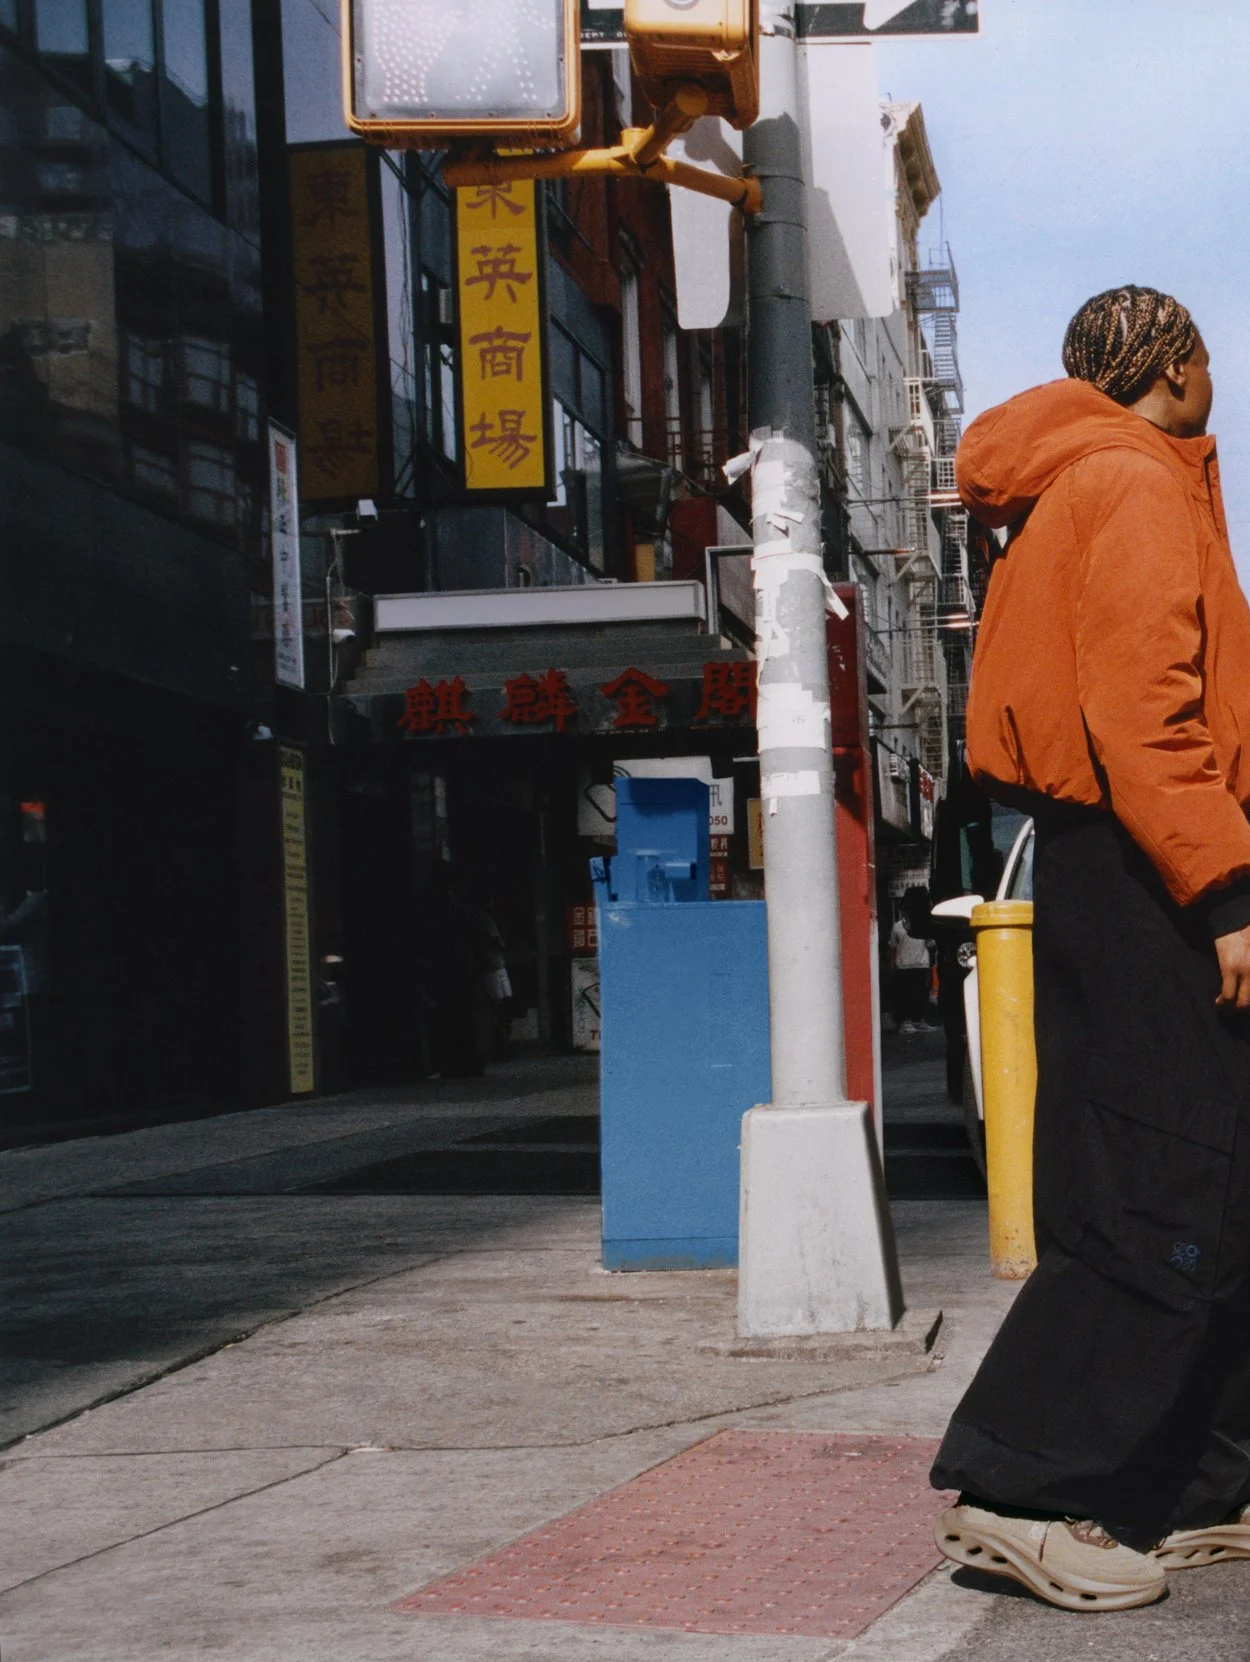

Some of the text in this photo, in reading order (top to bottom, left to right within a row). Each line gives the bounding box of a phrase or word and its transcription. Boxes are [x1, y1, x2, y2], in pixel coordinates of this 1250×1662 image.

[464, 178, 537, 470] 東英商場
[397, 661, 758, 734] 麒麟金閣
